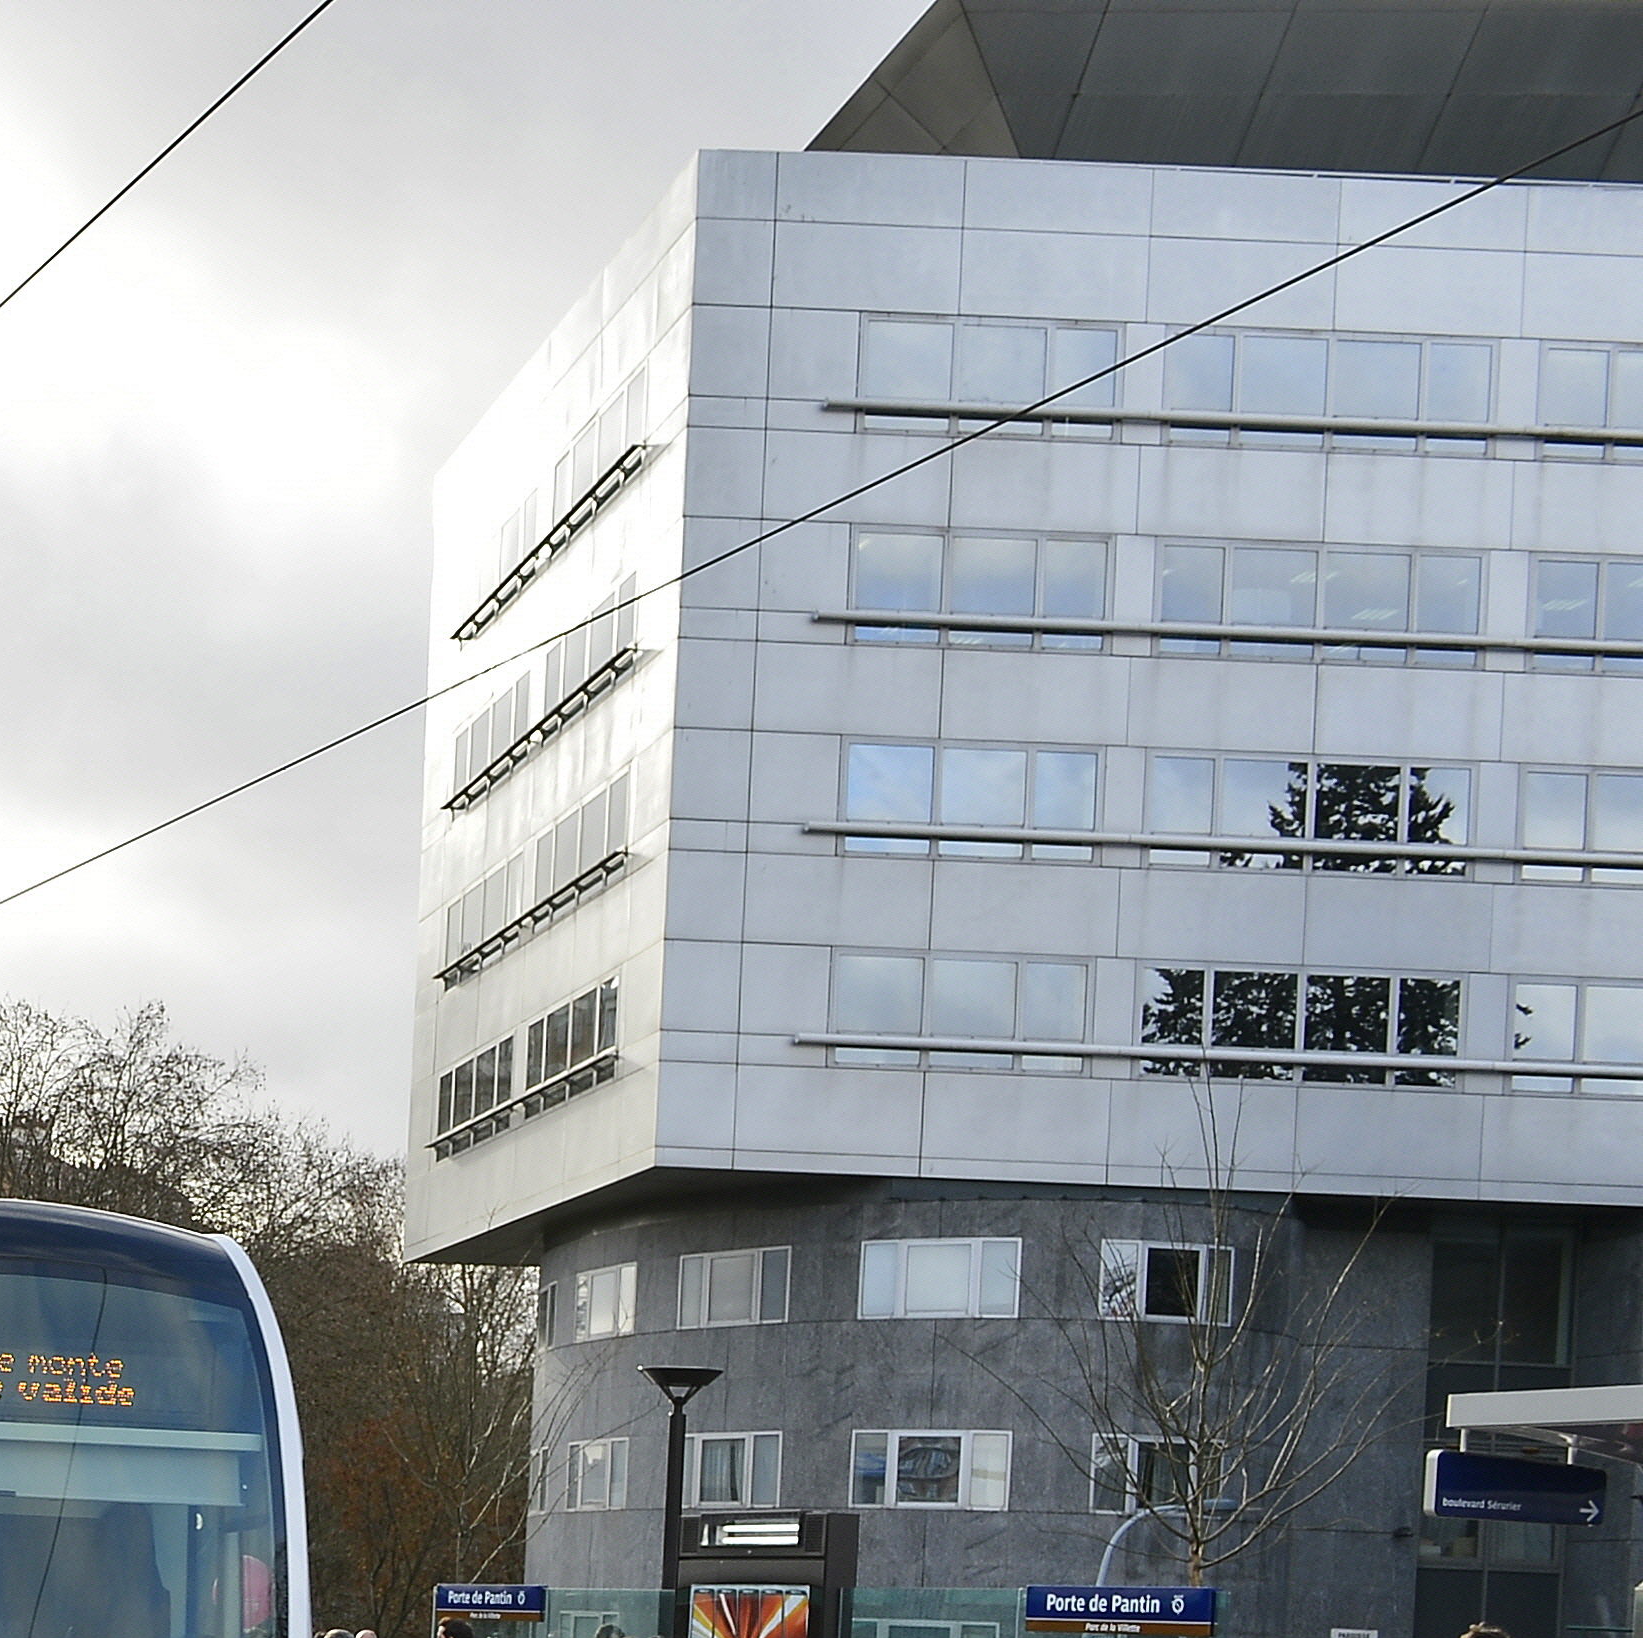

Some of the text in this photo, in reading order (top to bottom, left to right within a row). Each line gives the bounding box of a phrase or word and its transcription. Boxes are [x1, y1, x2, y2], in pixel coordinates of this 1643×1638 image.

[28, 1352, 124, 1378] monte
[18, 1377, 135, 1407] valide
[1442, 1497, 1522, 1511] boulevard Sérurier
[448, 1590, 512, 1605] Porte de Pantin
[1046, 1593, 1160, 1613] Porte de Pantin
